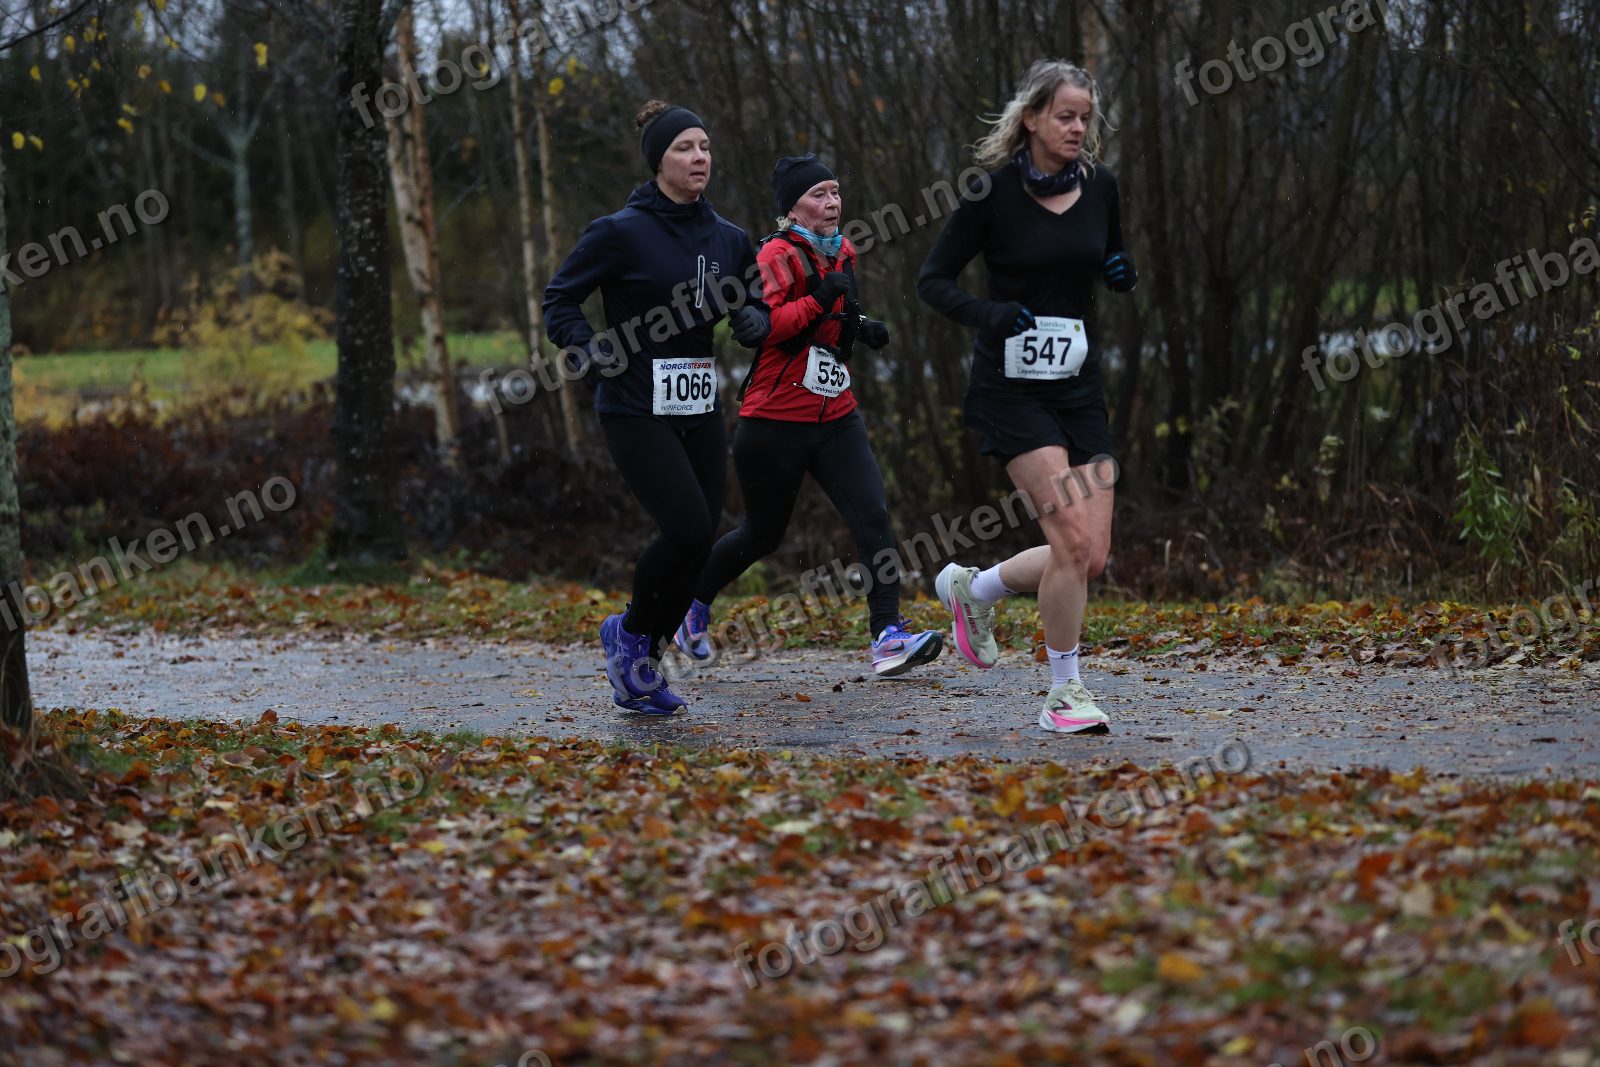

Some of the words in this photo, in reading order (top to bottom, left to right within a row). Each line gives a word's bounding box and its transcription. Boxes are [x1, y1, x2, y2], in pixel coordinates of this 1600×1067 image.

[1021, 336, 1072, 366] 547
[660, 362, 712, 371] NORGESTESTEN
[662, 372, 712, 401] 1066
